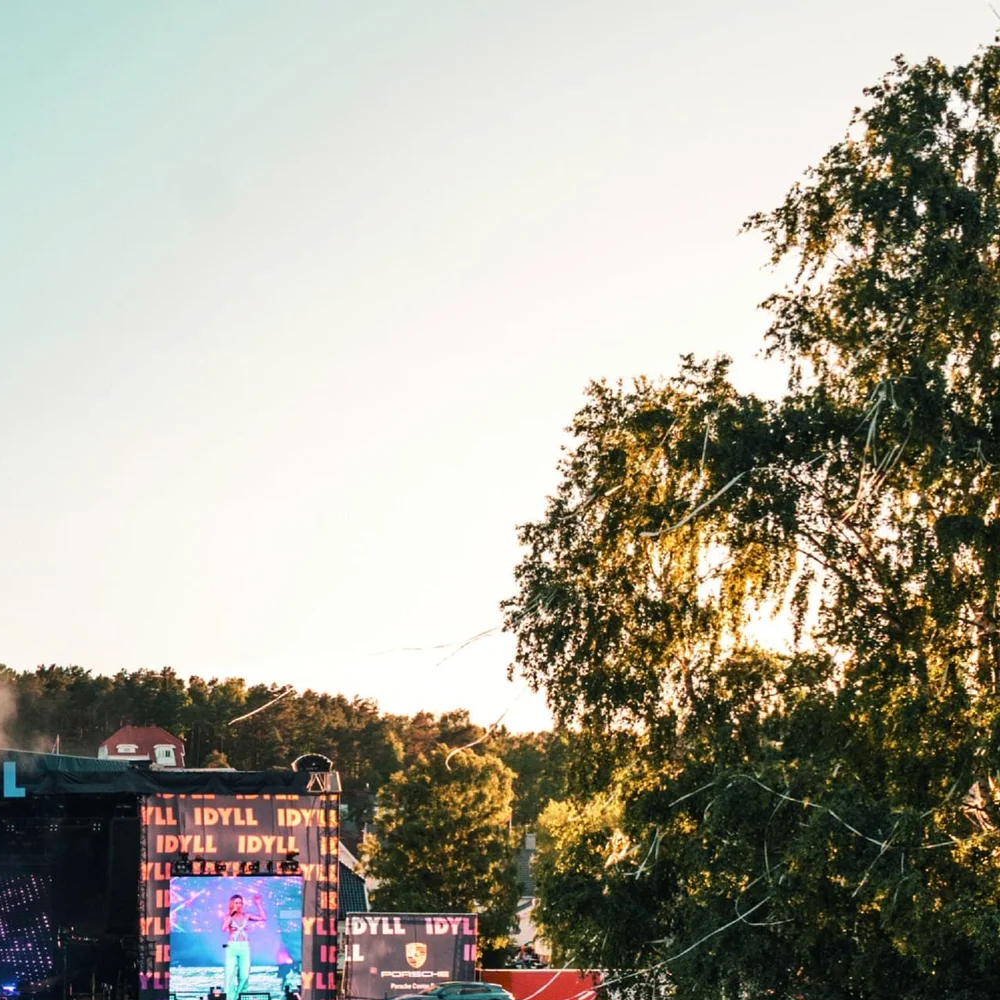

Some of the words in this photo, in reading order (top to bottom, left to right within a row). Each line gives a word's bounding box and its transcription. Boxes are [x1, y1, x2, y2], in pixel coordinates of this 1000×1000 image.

[194, 807, 258, 826] IDYLL
[278, 808, 338, 827] IDYLL
[156, 835, 217, 853] IDYLL
[238, 835, 300, 853] IDYLL
[425, 917, 477, 936] IDYL
[381, 970, 450, 978] PORSCHE
